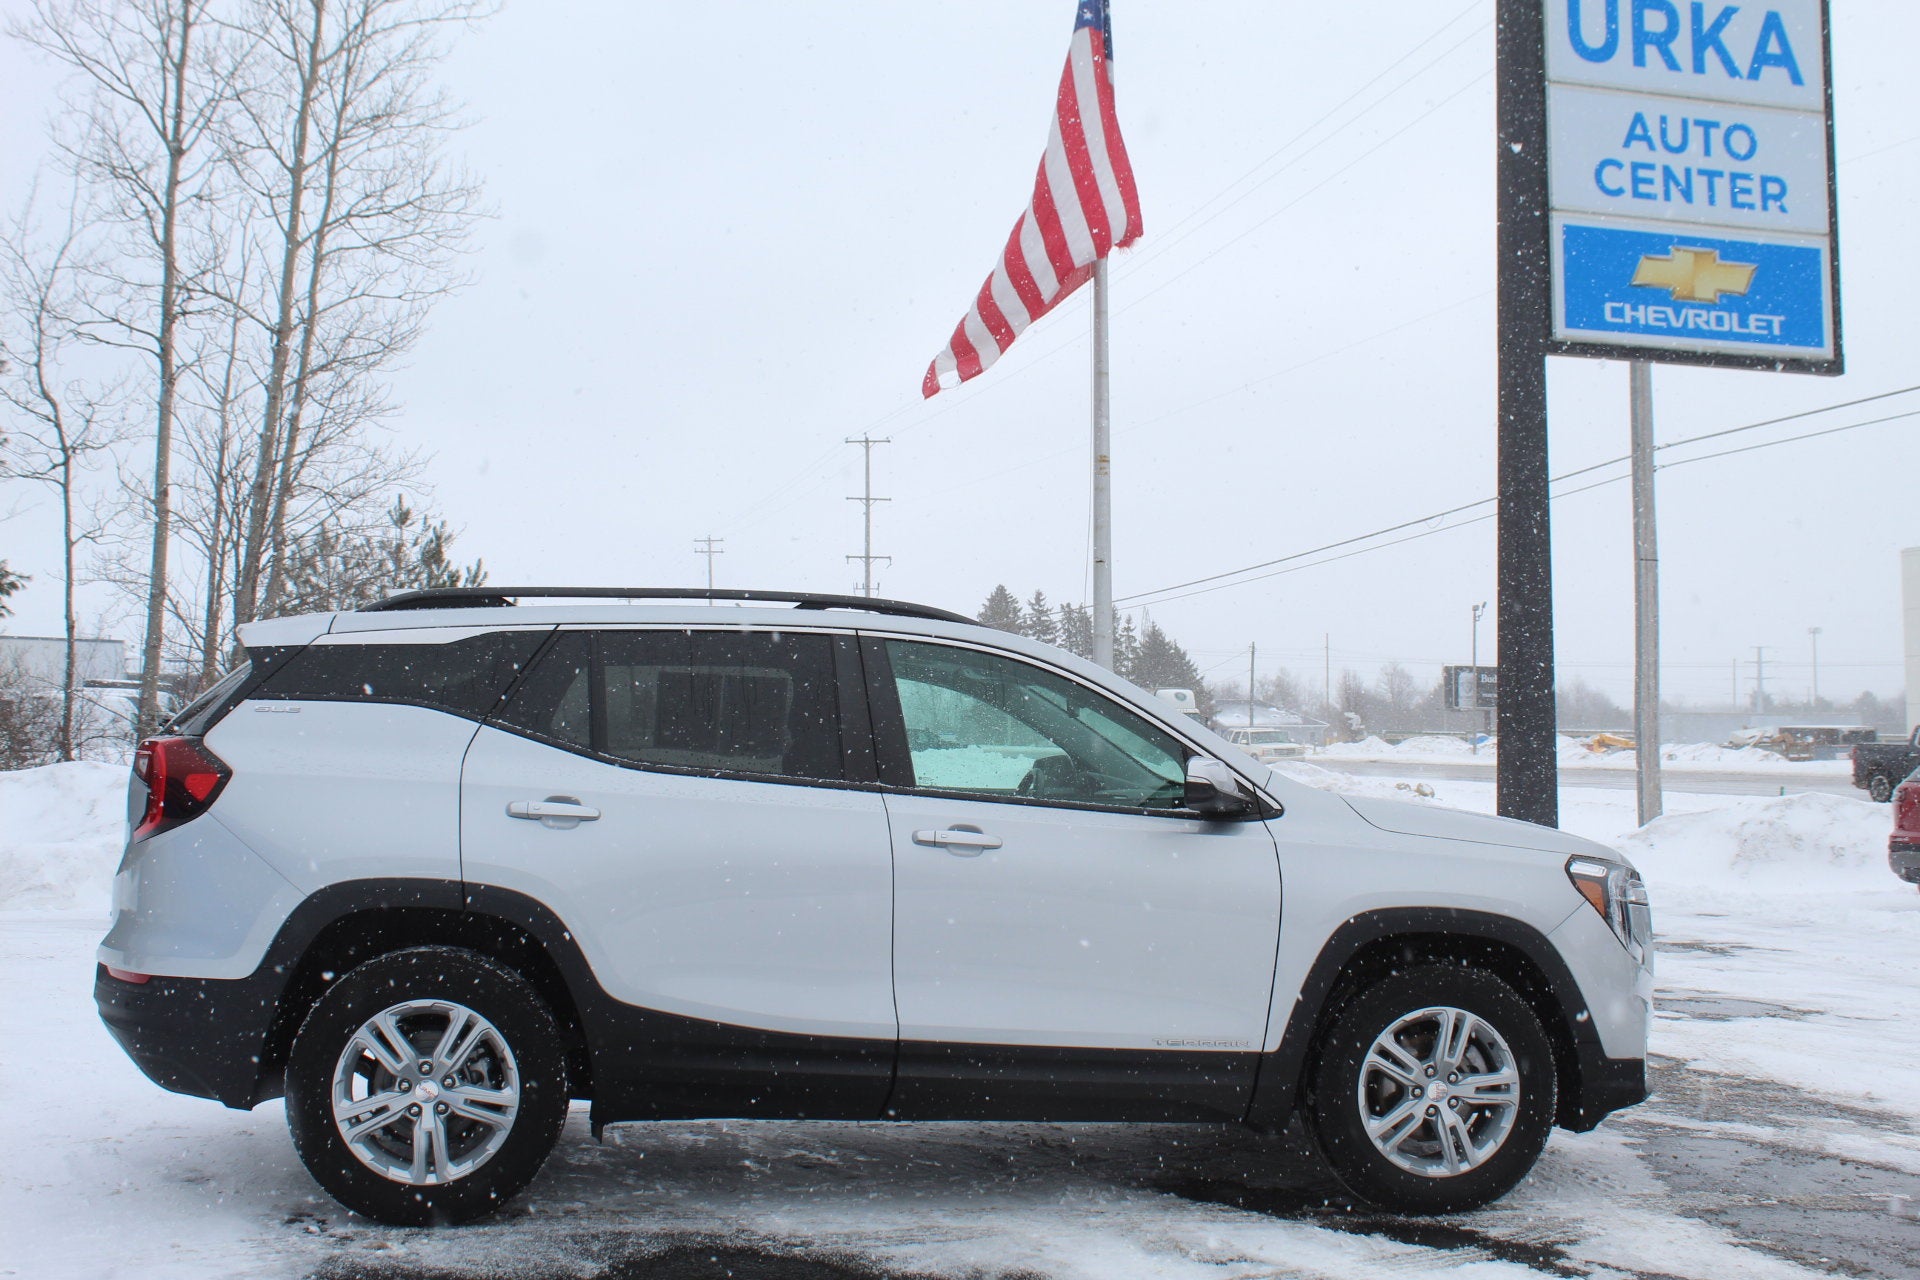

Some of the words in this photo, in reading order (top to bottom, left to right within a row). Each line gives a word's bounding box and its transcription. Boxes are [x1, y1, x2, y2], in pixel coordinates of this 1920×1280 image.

[1567, 0, 1804, 86] URKA
[1622, 111, 1758, 162] AUTO
[1594, 158, 1789, 213] CENTER
[1604, 302, 1785, 335] CHEVROLET
